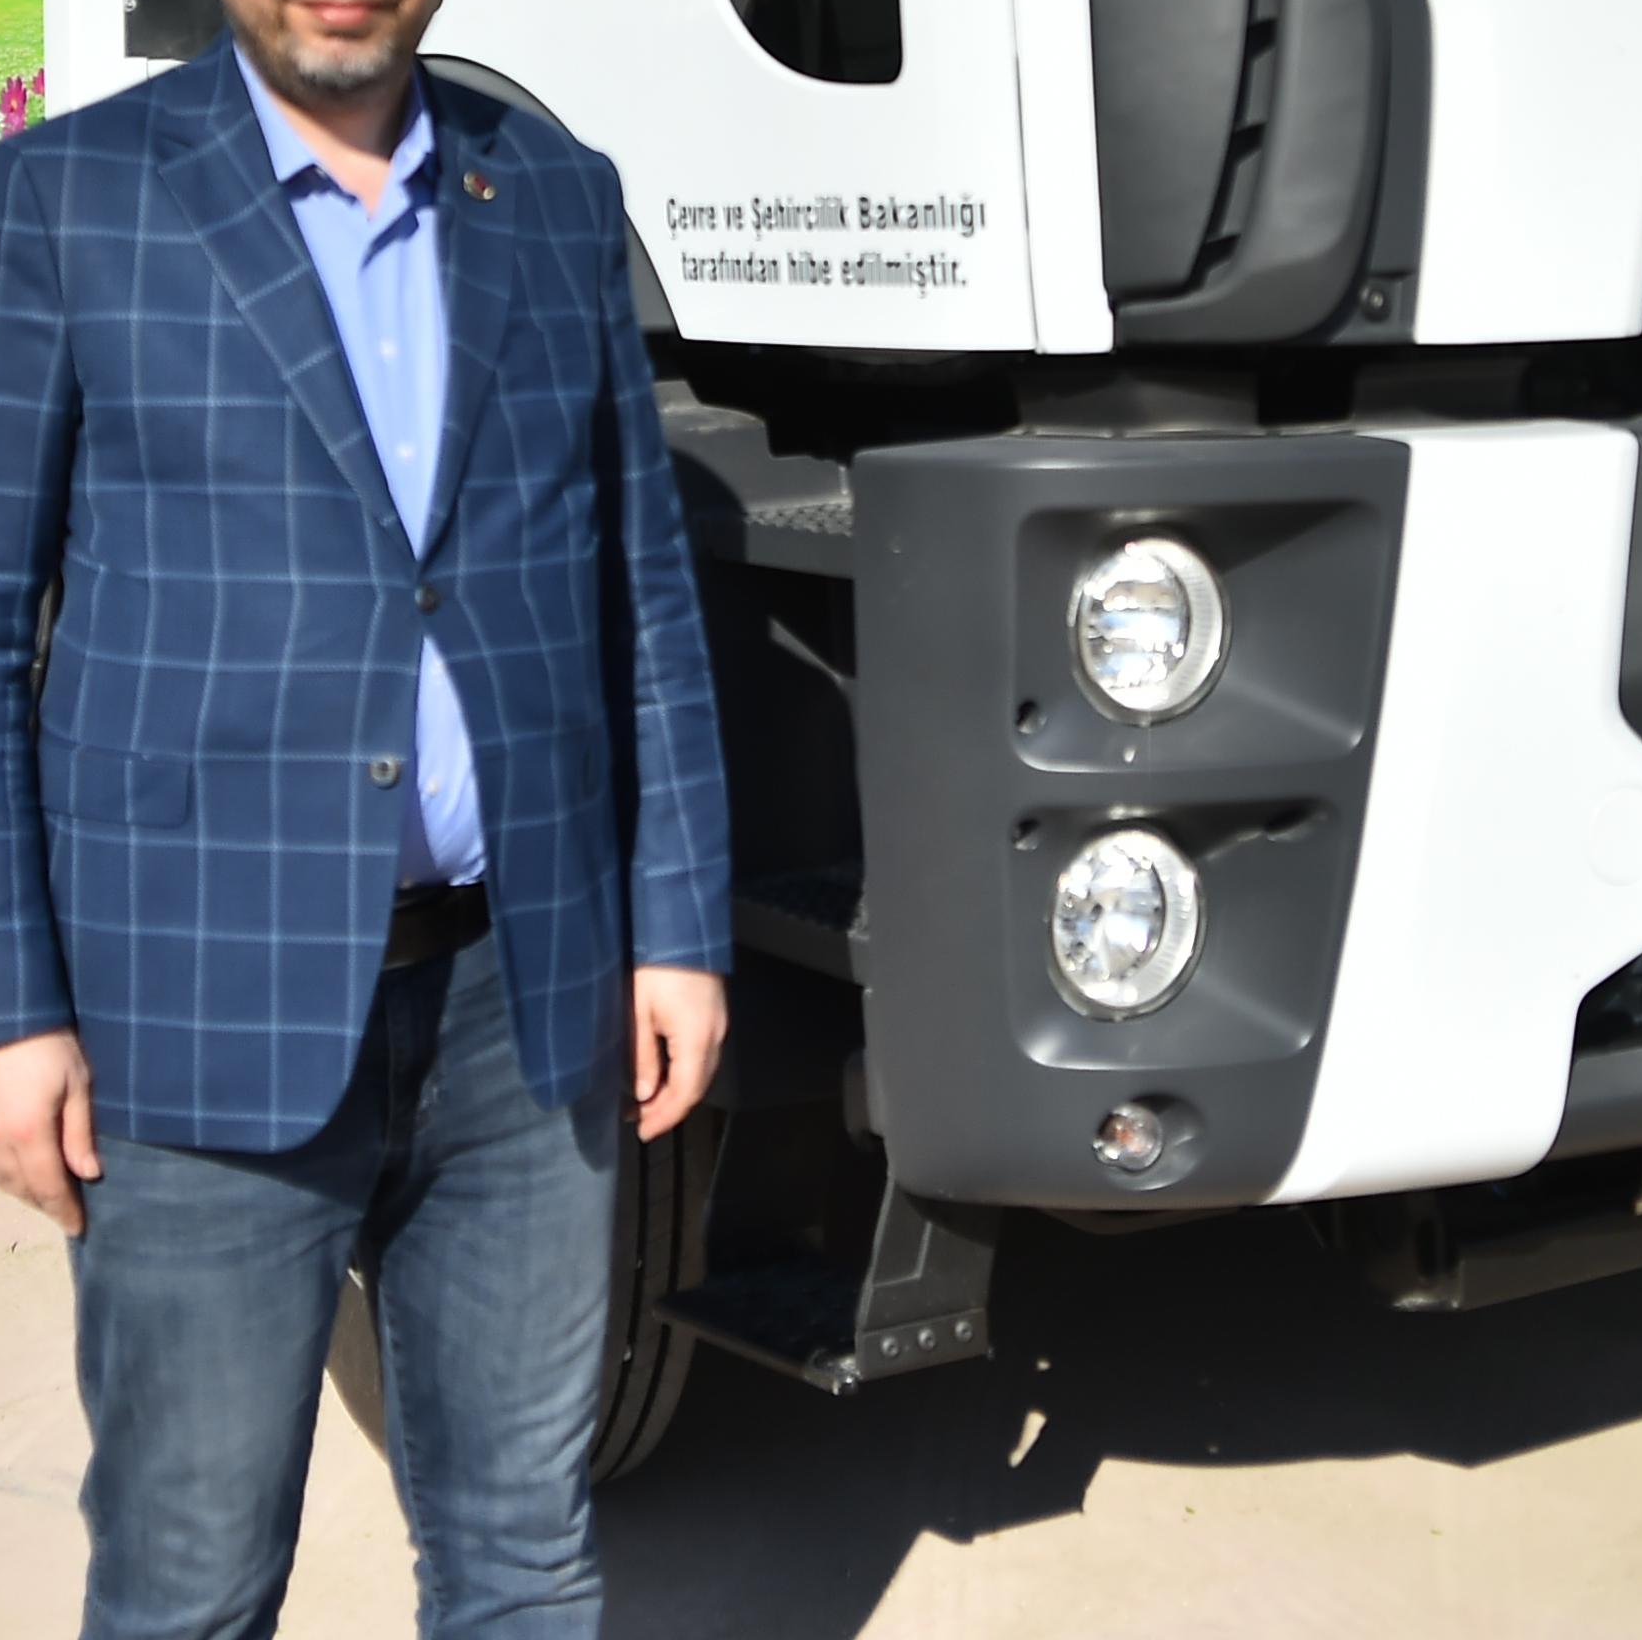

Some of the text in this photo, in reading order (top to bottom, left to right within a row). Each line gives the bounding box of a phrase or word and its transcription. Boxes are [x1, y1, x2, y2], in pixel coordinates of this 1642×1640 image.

[667, 192, 986, 242] Çevre ve Şehircilik Bakanlığı
[681, 250, 967, 299] tarafından hibe edilmiştir.
